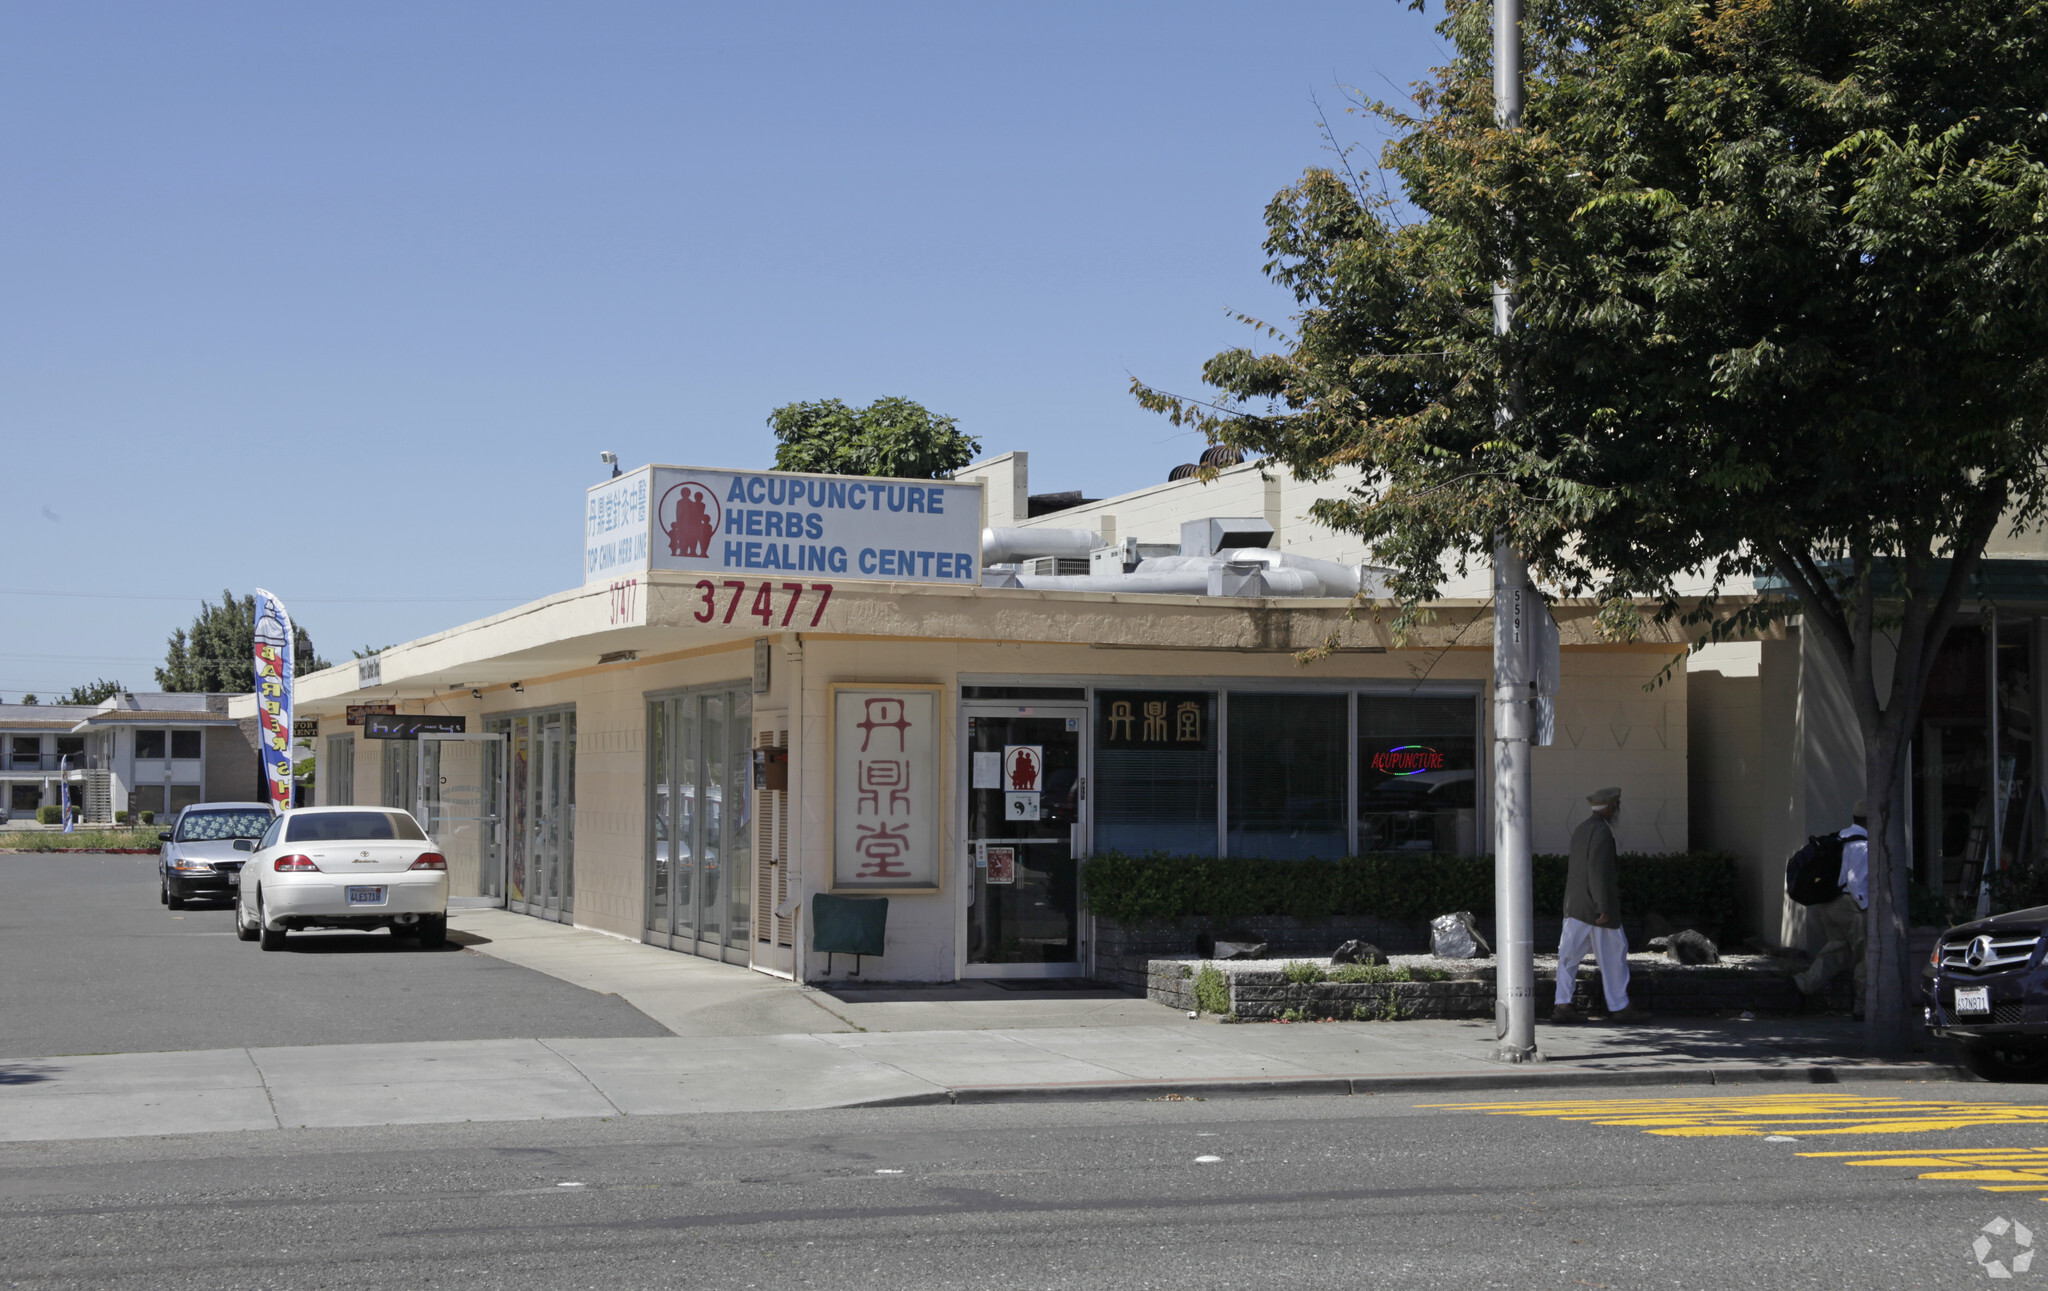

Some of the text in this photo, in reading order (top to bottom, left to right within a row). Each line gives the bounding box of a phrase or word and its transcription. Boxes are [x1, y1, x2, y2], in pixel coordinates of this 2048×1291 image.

[726, 477, 945, 515] ACUPUNCTURE
[725, 508, 823, 540] HERBS
[588, 531, 648, 574] TOP CHINA HERB LINE
[724, 540, 973, 580] HEALING CENTER
[610, 578, 637, 626] 37477
[693, 579, 834, 628] 37477
[1513, 590, 1521, 644] 5591
[1371, 752, 1445, 769] ACUPUNCTURE
